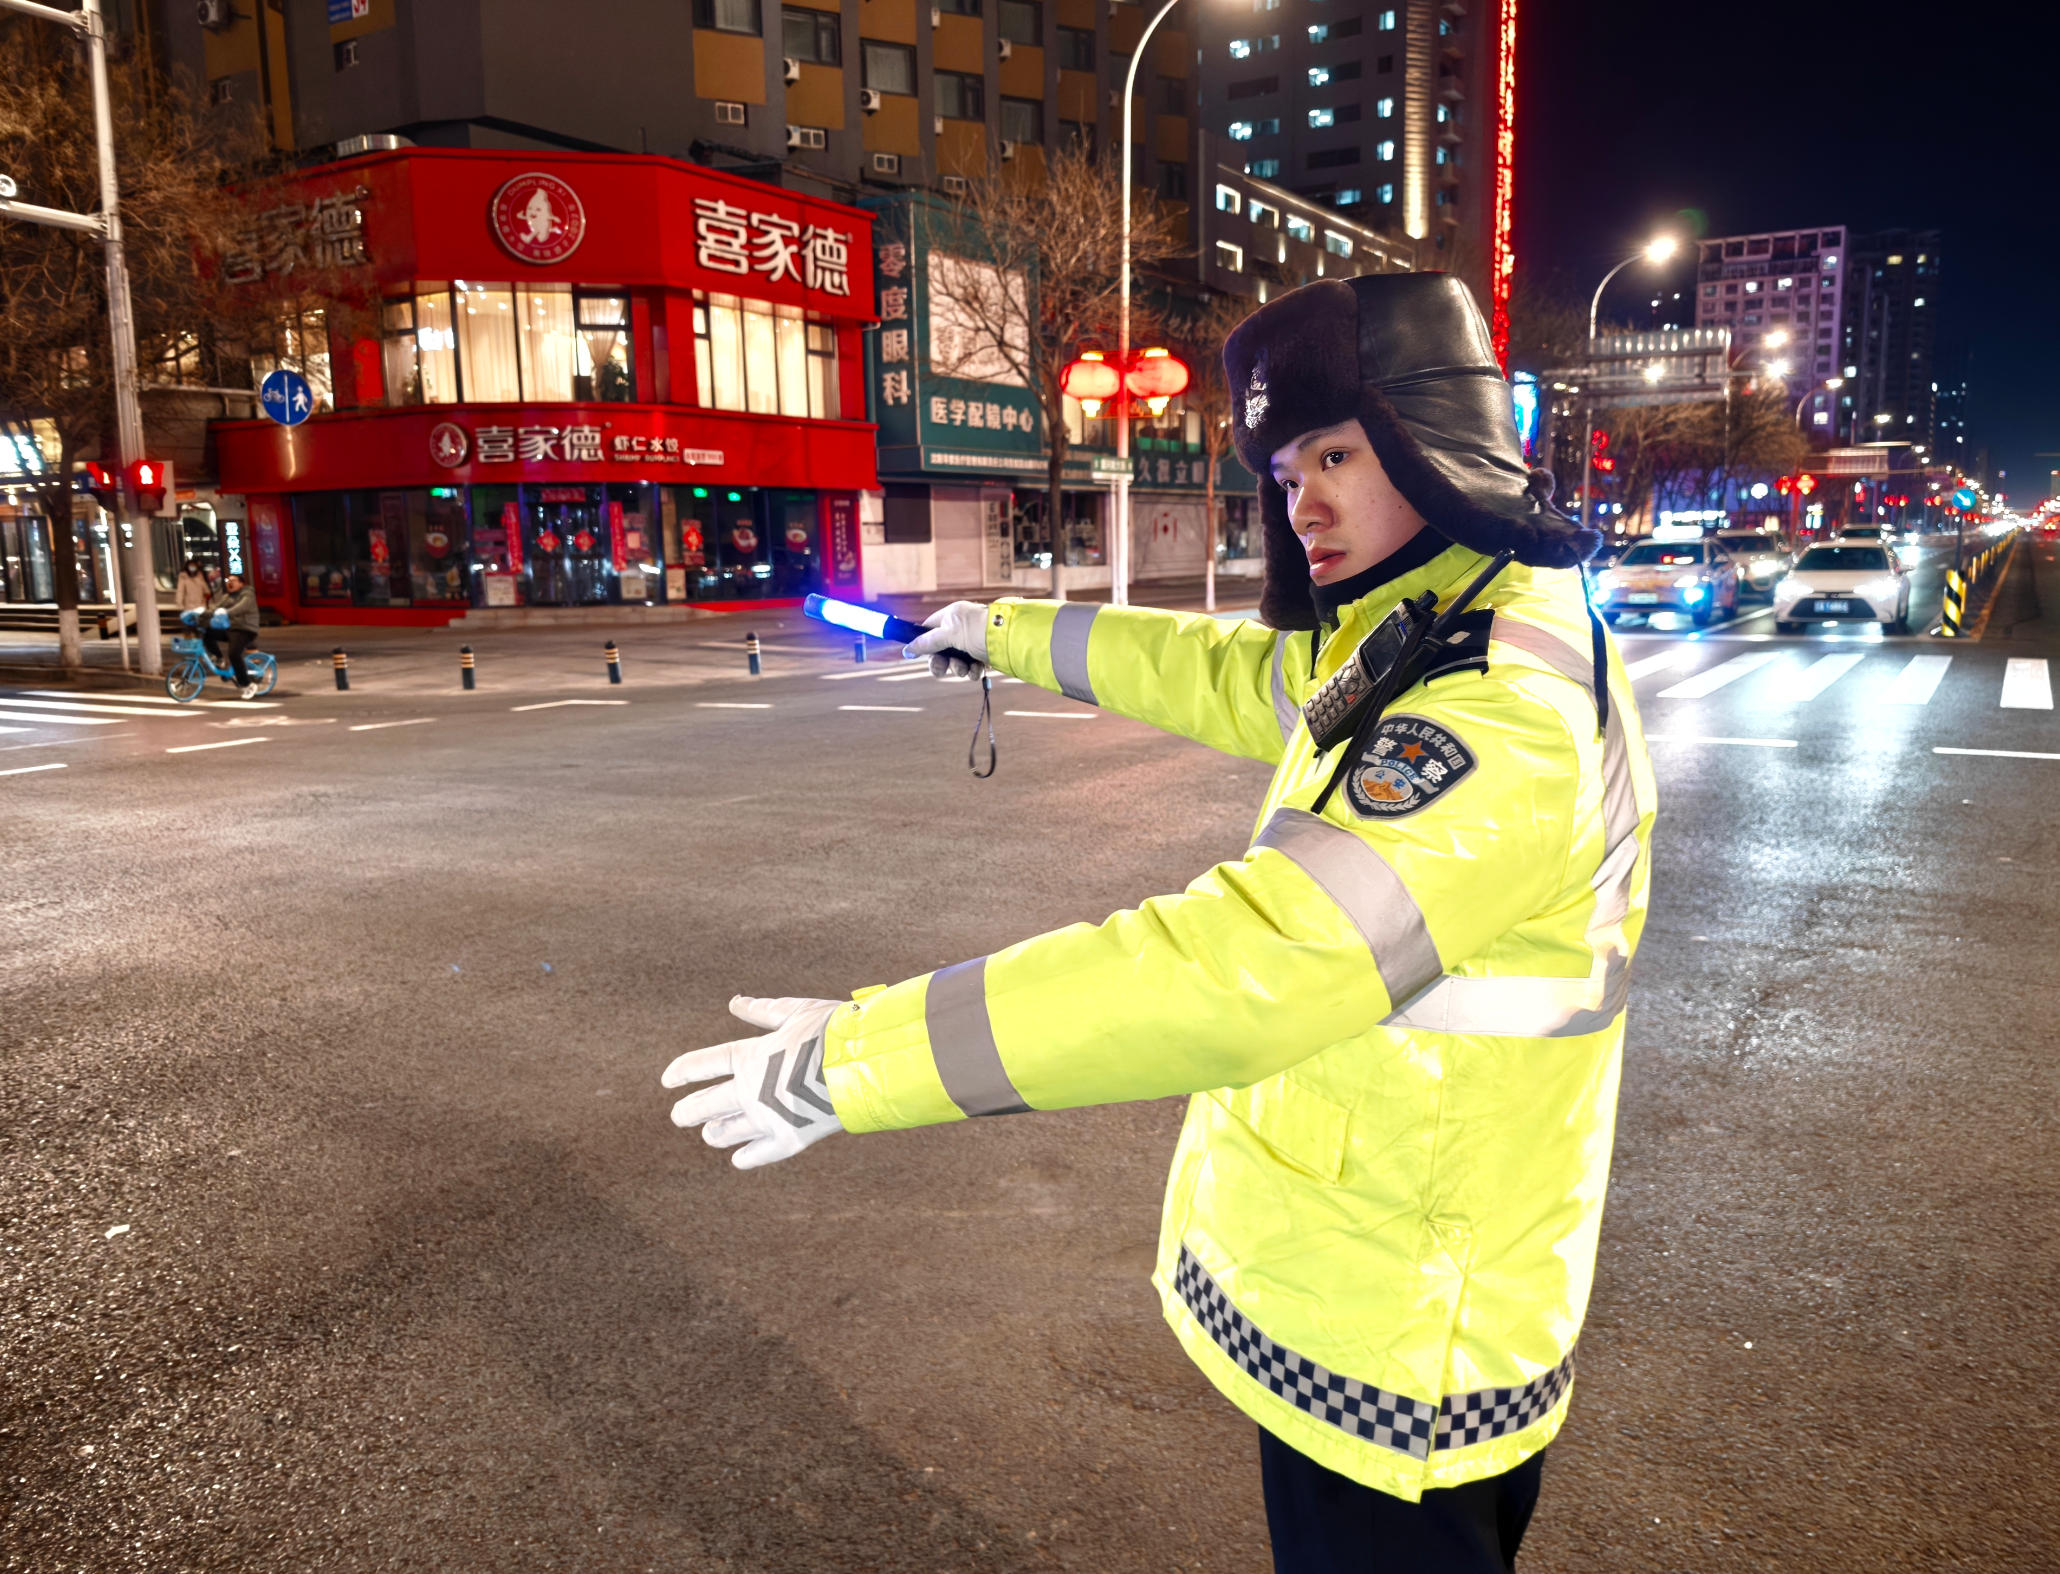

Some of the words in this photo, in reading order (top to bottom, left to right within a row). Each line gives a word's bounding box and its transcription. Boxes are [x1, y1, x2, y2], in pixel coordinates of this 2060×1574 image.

[507, 179, 556, 197] DUMPLING
[694, 198, 851, 297] 喜家德
[930, 396, 1034, 433] 医学配镜中心
[475, 425, 605, 463] 喜家德
[613, 435, 679, 453] 虾仁水饺
[1381, 723, 1466, 770] 中华人民共和国
[1380, 759, 1418, 781] POLICE
